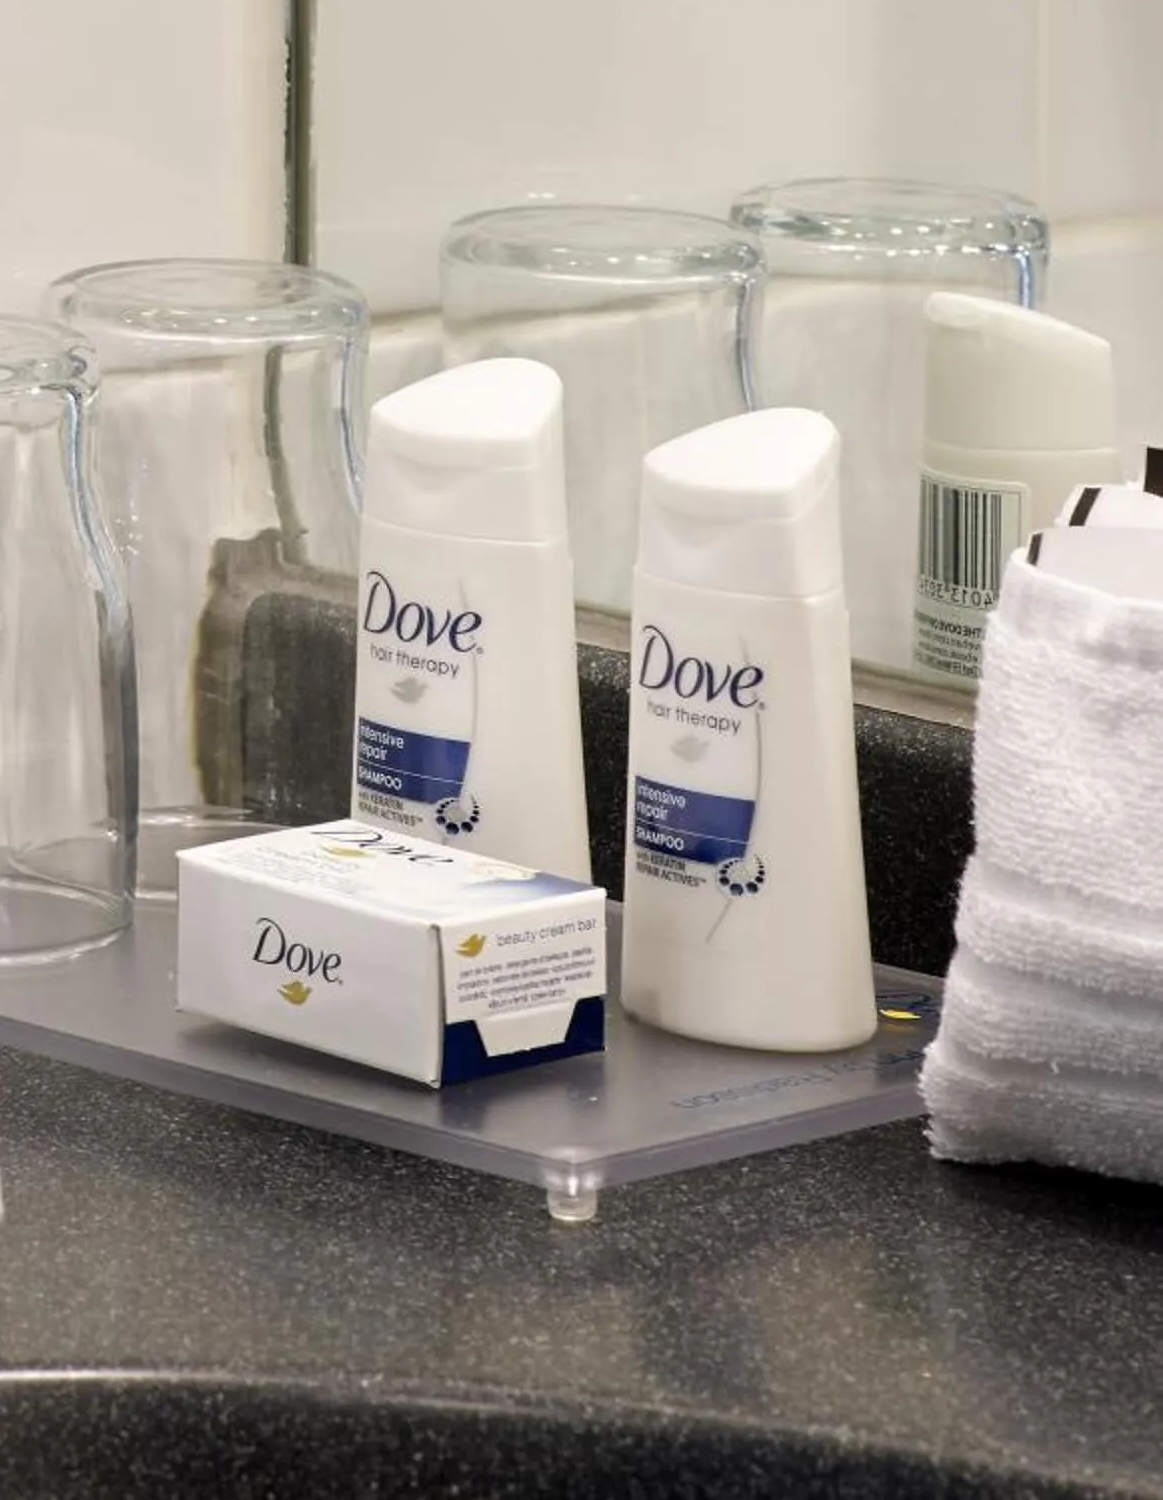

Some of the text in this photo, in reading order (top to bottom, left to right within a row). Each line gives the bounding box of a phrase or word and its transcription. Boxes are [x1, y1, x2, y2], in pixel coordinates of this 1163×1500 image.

[363, 570, 482, 653] Dove
[370, 642, 461, 679] hair therapy
[639, 624, 764, 708] Dove
[647, 699, 742, 737] hair therapy
[252, 916, 343, 985] Dove
[496, 918, 597, 947] beauty cream bar
